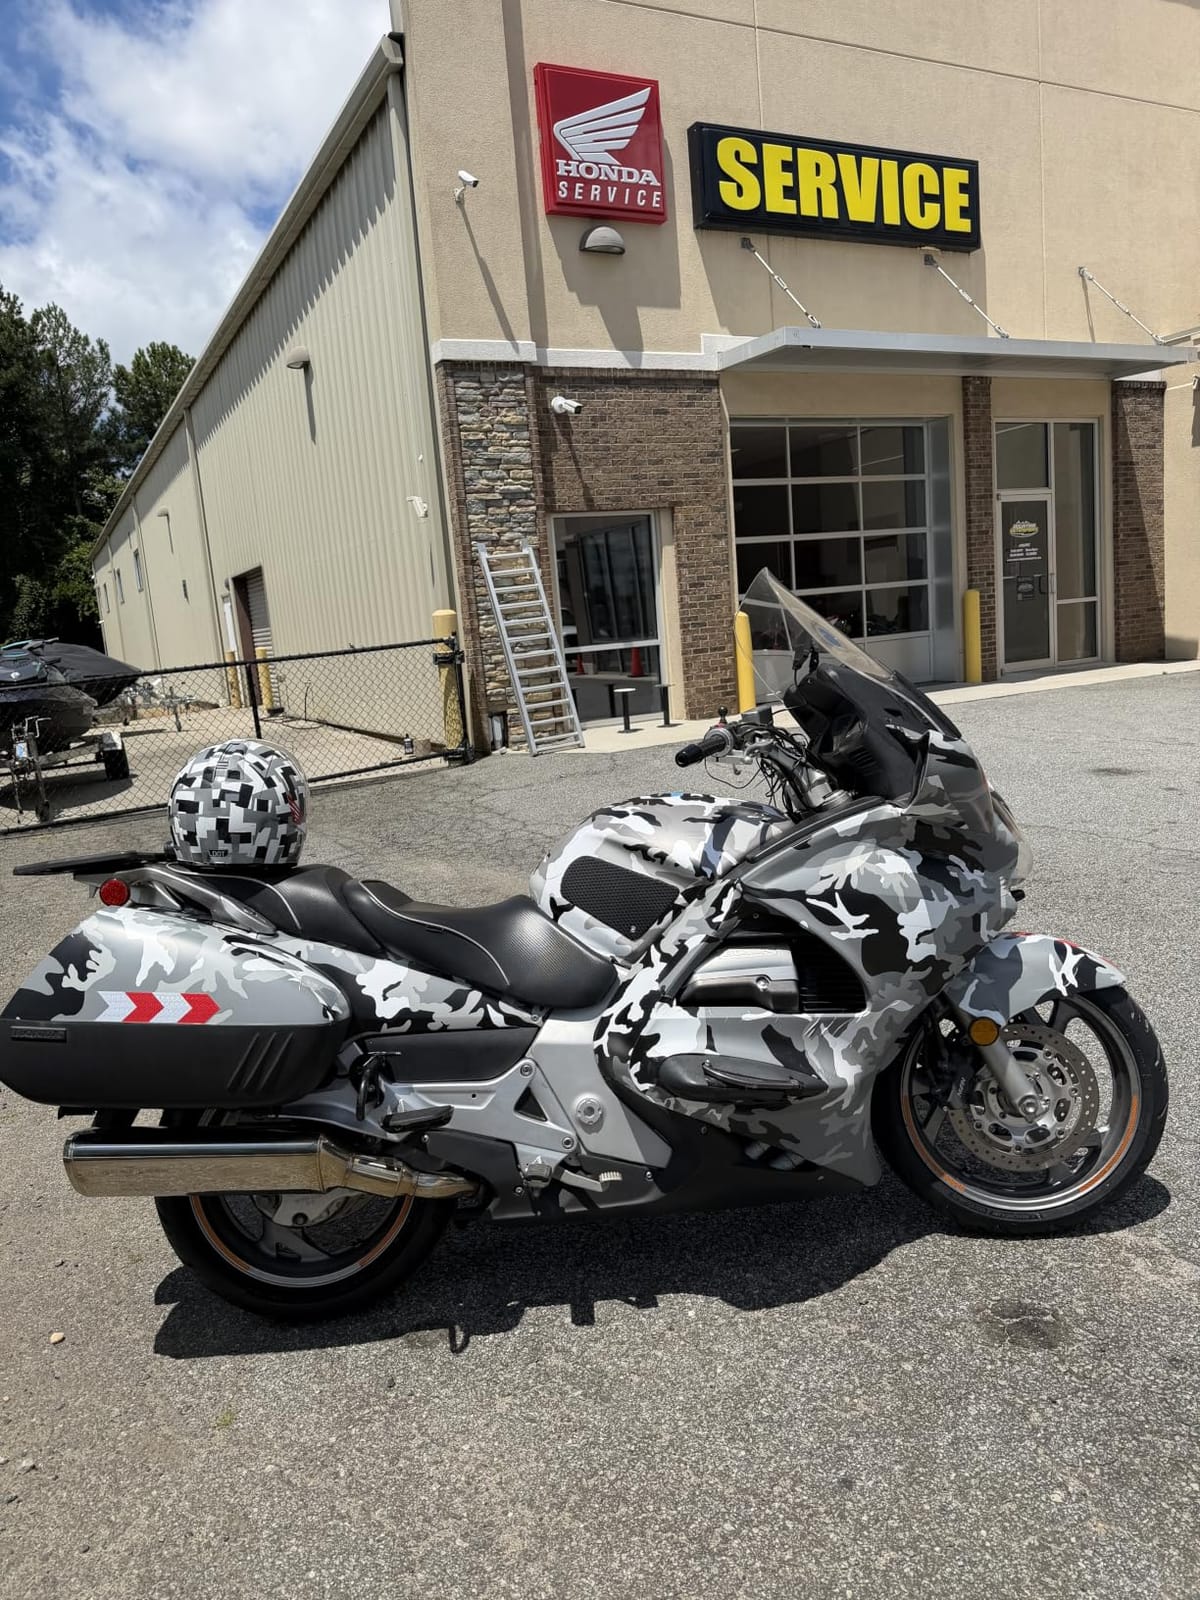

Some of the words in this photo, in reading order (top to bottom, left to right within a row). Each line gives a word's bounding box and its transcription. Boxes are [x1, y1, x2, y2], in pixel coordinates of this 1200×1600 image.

[556, 159, 661, 186] HONDA
[717, 137, 971, 233] SERVICE
[558, 181, 662, 208] SERVICE
